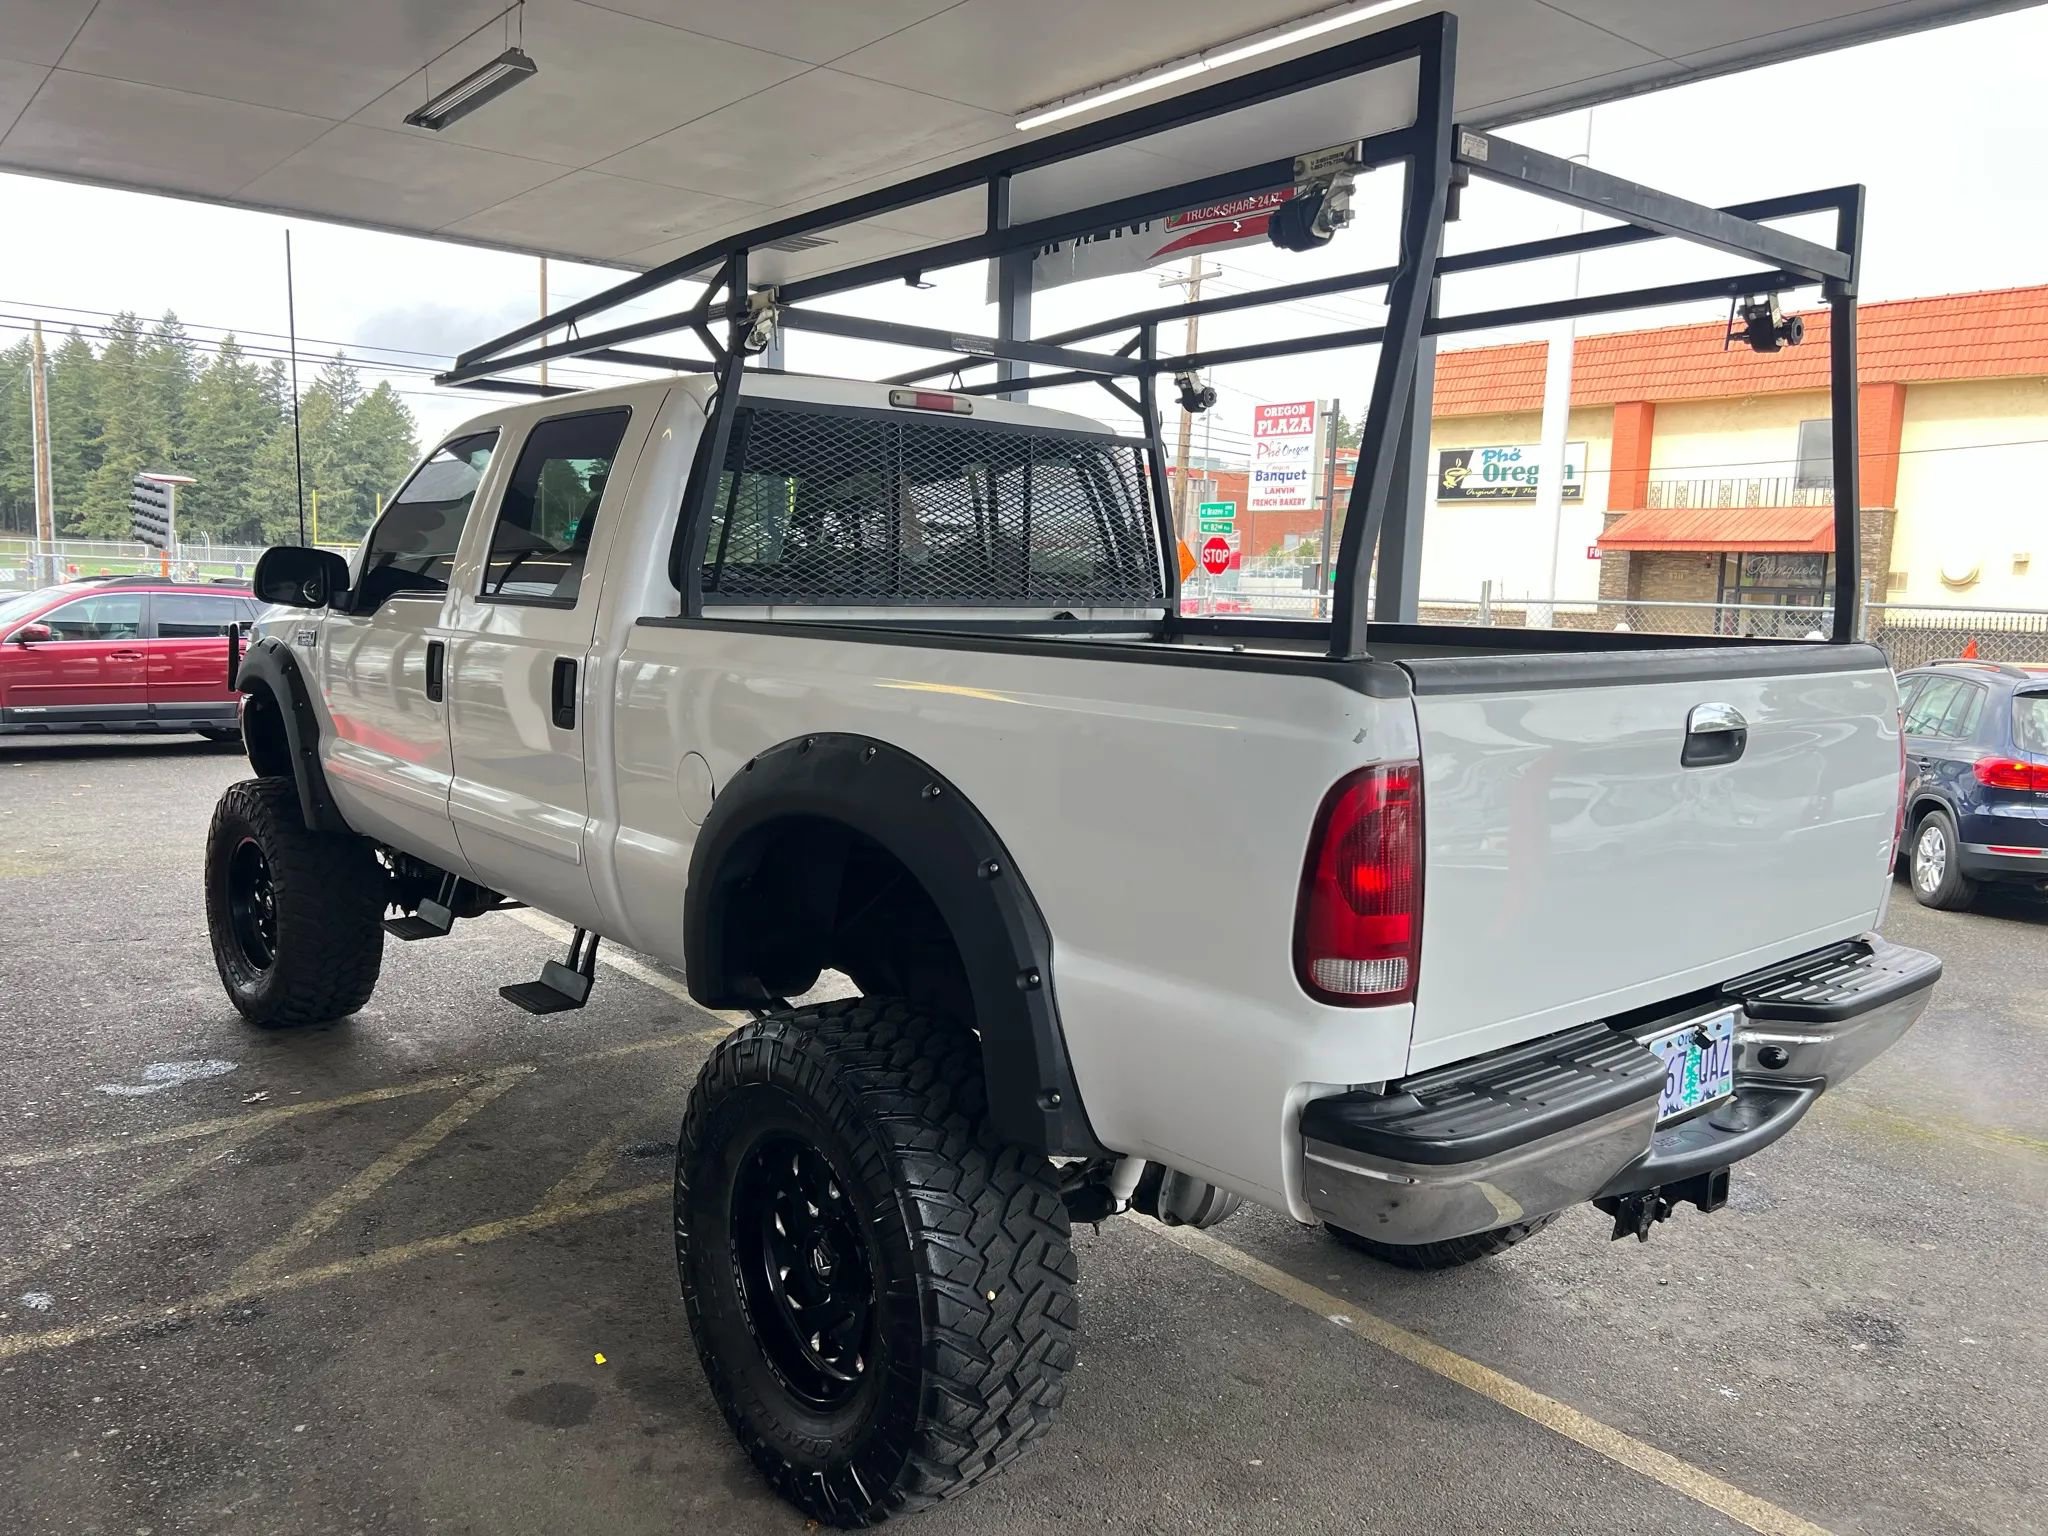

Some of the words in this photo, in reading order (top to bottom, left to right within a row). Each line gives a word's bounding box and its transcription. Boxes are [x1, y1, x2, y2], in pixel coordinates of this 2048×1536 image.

[1264, 405, 1306, 417] OREGON
[1257, 417, 1311, 435] PLAZA
[1255, 469, 1307, 484] Banquet
[1483, 463, 1574, 485] Oregn
[1252, 499, 1278, 507] FRENCH
[1279, 497, 1306, 506] BAKERY
[1203, 548, 1229, 564] STOP
[1589, 547, 1602, 558] FD
[1747, 556, 1817, 578] Banquet
[1664, 1051, 1687, 1099] 67
